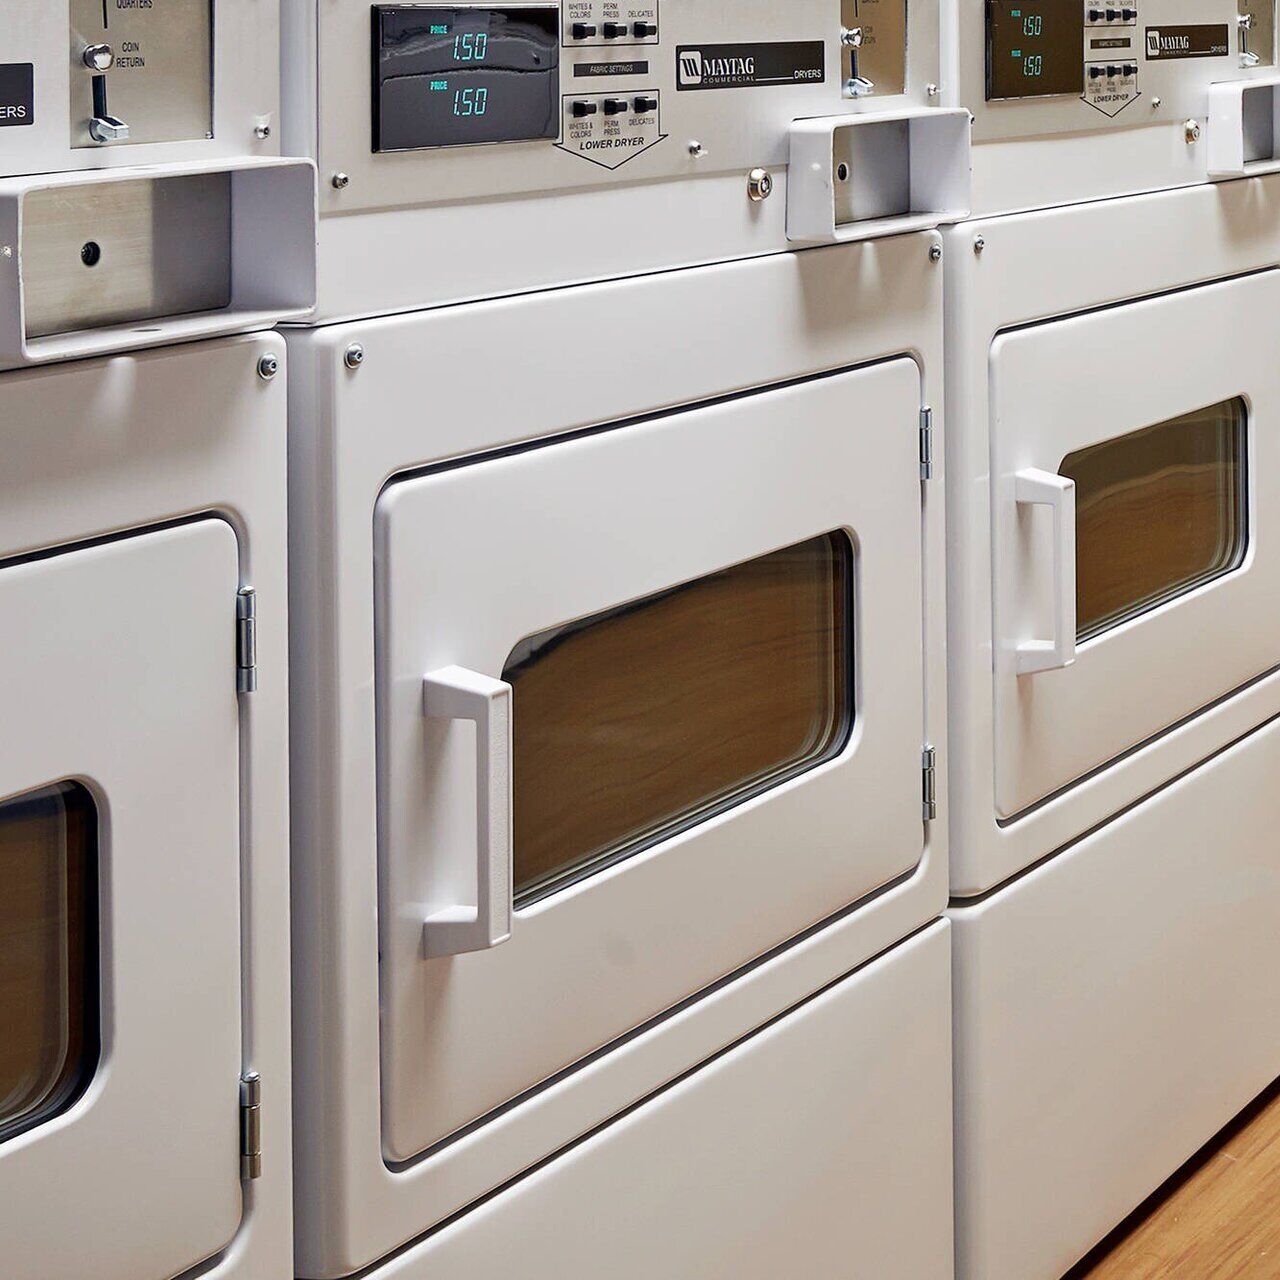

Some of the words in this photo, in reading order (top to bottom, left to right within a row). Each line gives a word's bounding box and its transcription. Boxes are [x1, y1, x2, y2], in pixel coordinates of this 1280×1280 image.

[603, 2, 618, 10] PERM
[569, 11, 592, 19] COLORS
[602, 10, 619, 19] PRESS
[627, 10, 654, 18] DELICATES
[122, 42, 139, 53] COIN
[453, 33, 488, 60] 1.50
[1160, 35, 1190, 51] MAYTAG
[116, 57, 145, 68] RETURN
[702, 57, 754, 76] MAYTAG
[703, 75, 755, 84] COMMERCIAL
[793, 69, 822, 79] DRYERS
[453, 88, 488, 116] 1.50
[628, 117, 655, 126] DELICATES
[579, 139, 613, 151] LOWER
[614, 136, 645, 147] DRYER
